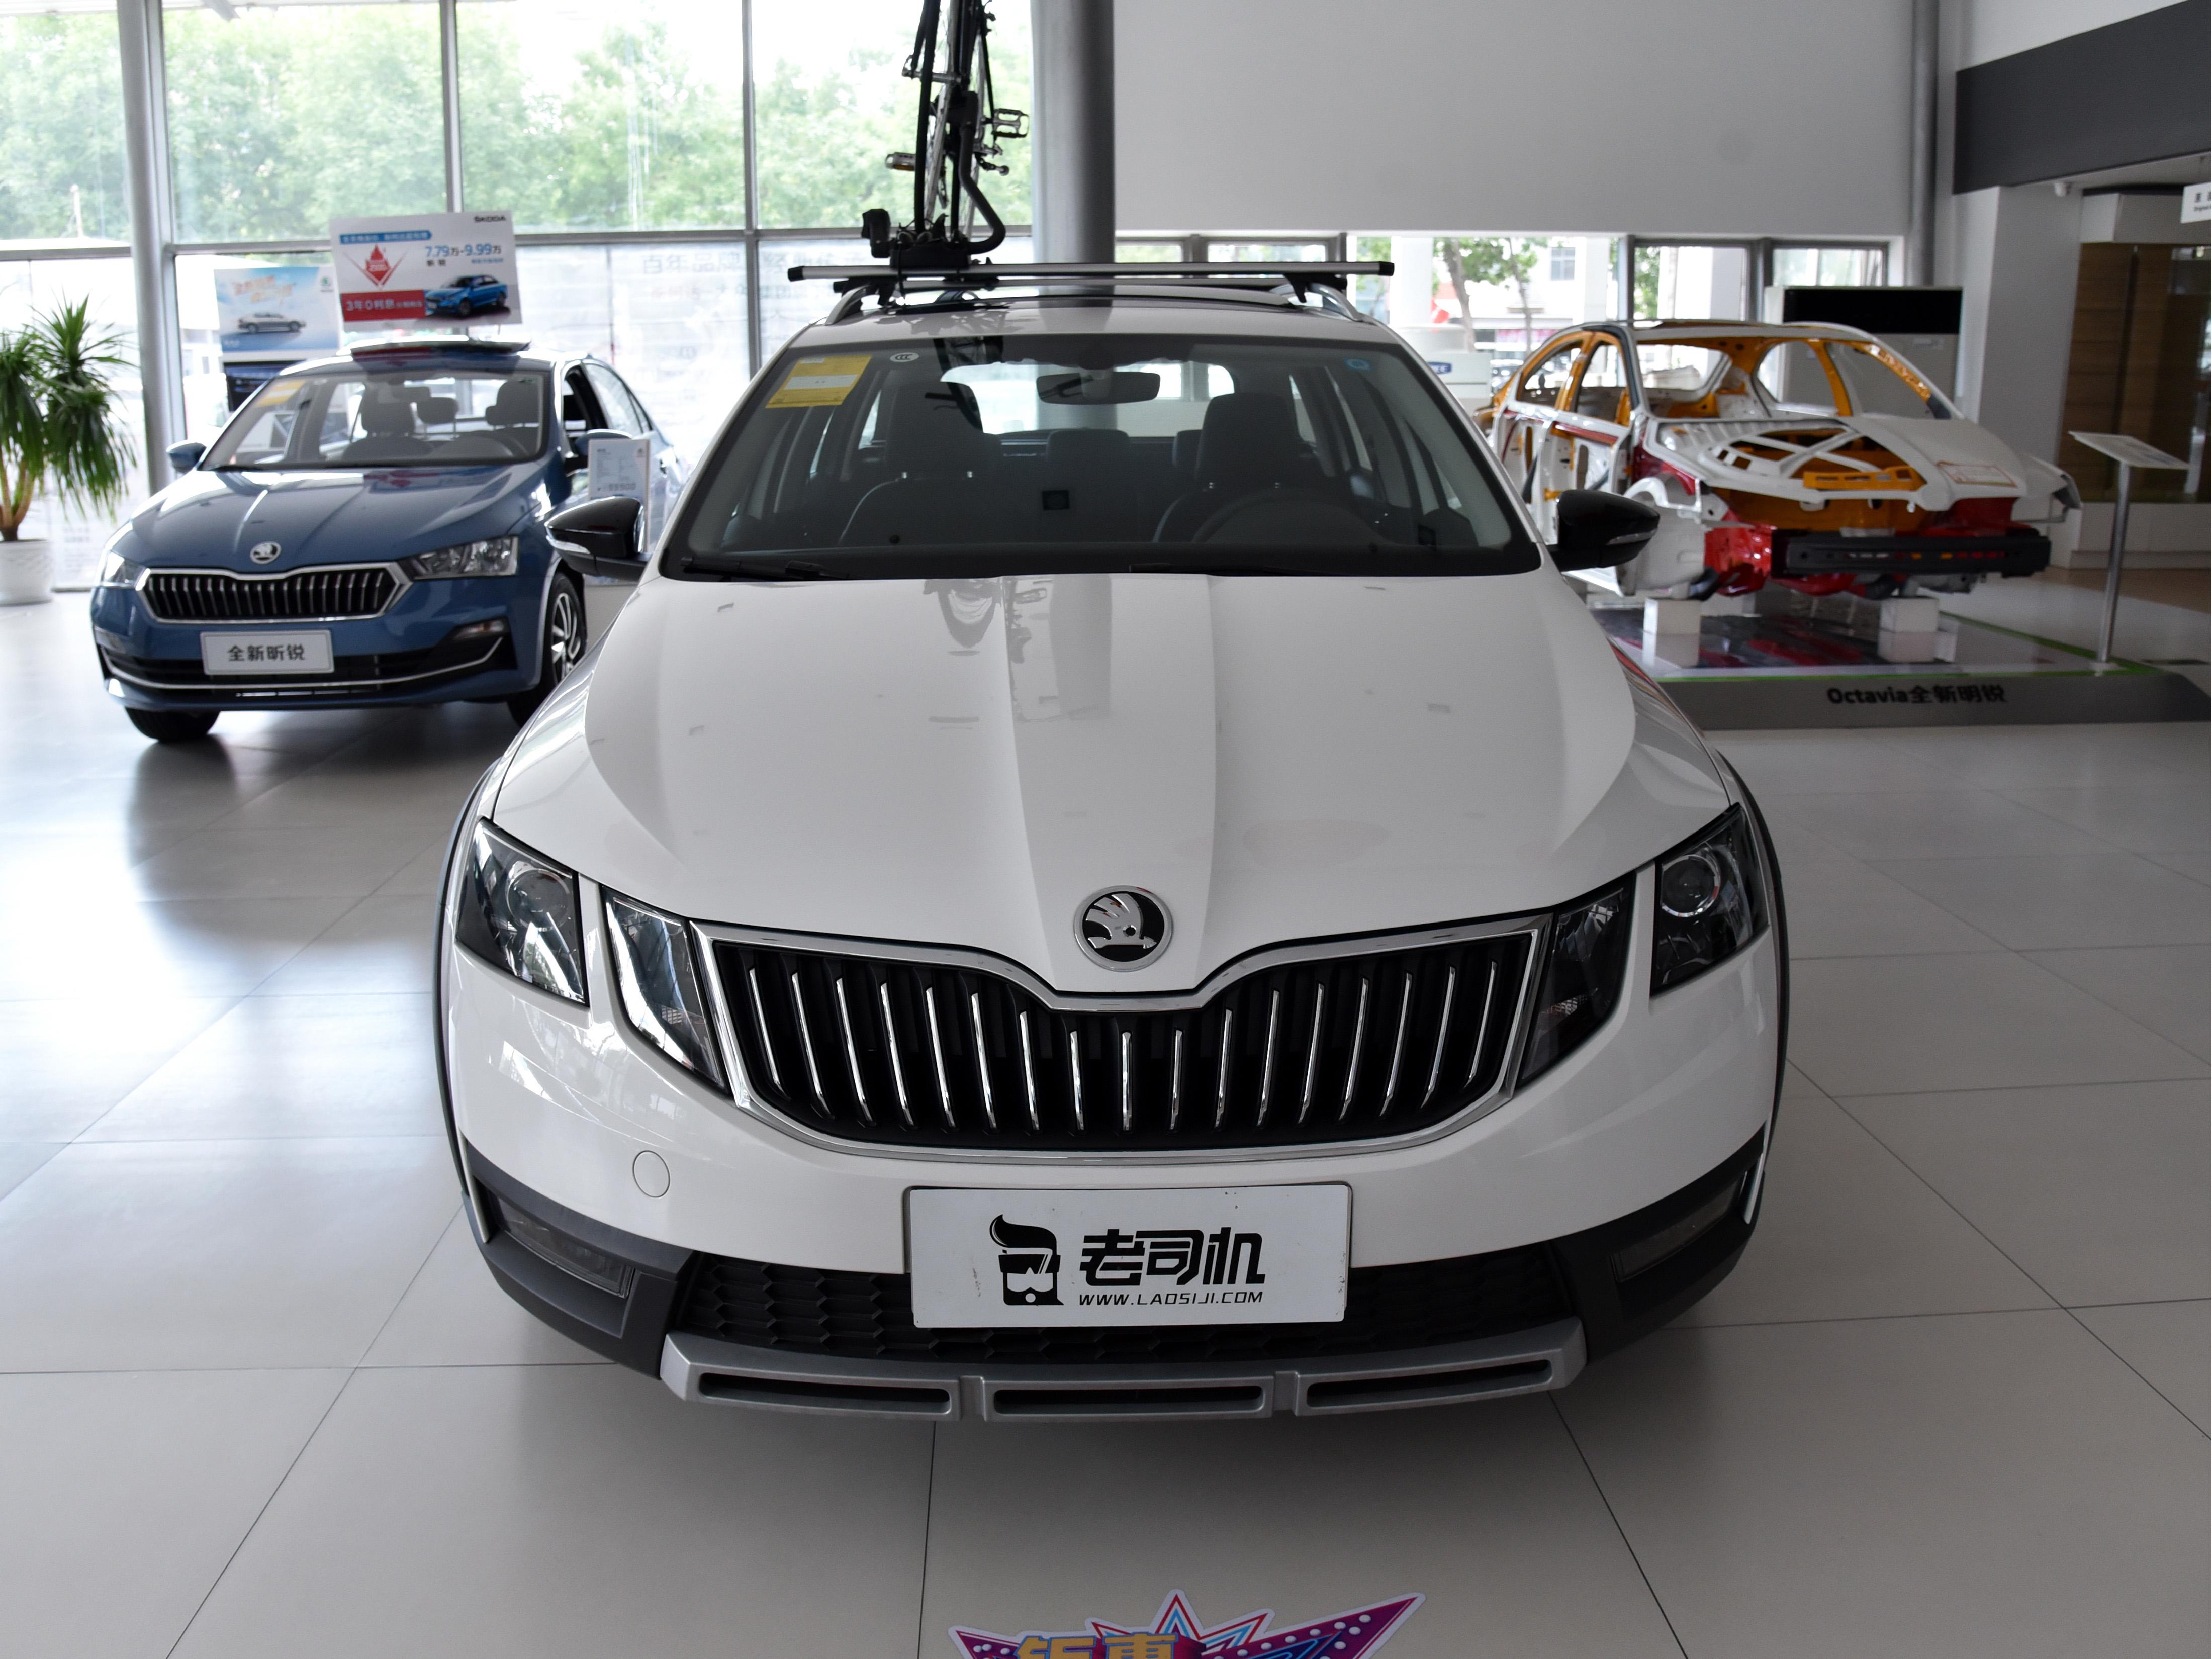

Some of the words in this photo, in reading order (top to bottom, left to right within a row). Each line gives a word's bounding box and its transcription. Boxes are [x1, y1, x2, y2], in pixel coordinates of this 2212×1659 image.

[228, 644, 305, 662] 全新昕锐
[1080, 1227, 1266, 1286] 老司机
[1079, 1291, 1263, 1306] WWW.LAOSIJI.COM
